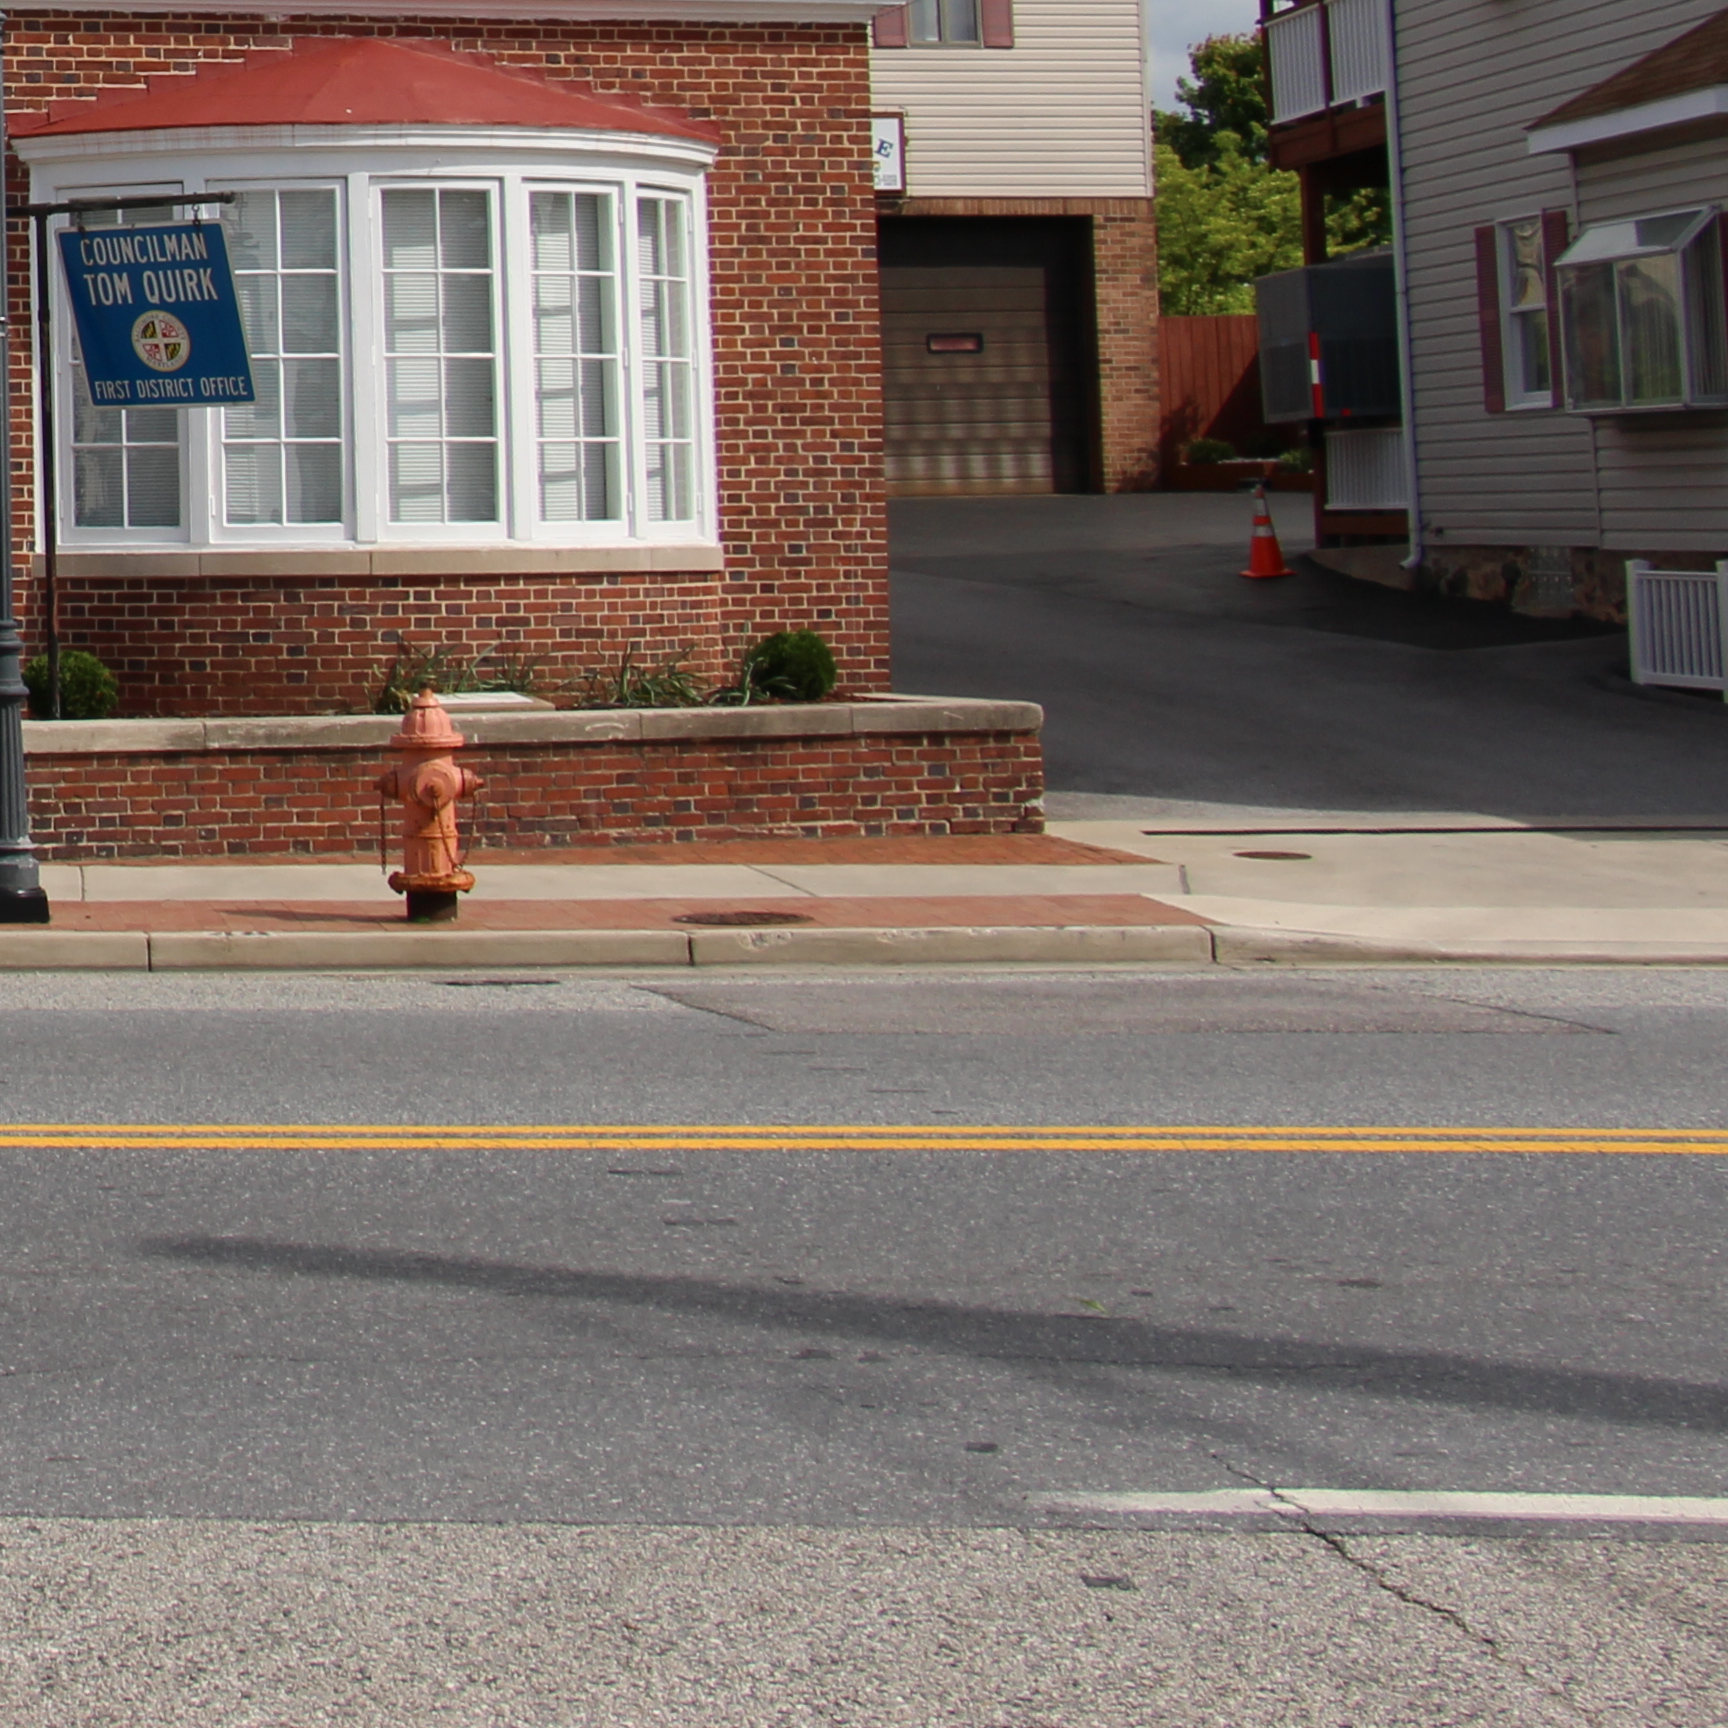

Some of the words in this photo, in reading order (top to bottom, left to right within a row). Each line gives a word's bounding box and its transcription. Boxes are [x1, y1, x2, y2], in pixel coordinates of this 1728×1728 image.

[79, 232, 209, 267] COUNCILMAN
[83, 272, 134, 307] TOM
[142, 267, 219, 305] QUIRK
[94, 380, 132, 400] FIRST
[136, 377, 195, 399] DISTRICT
[200, 376, 249, 397] OFFICE
